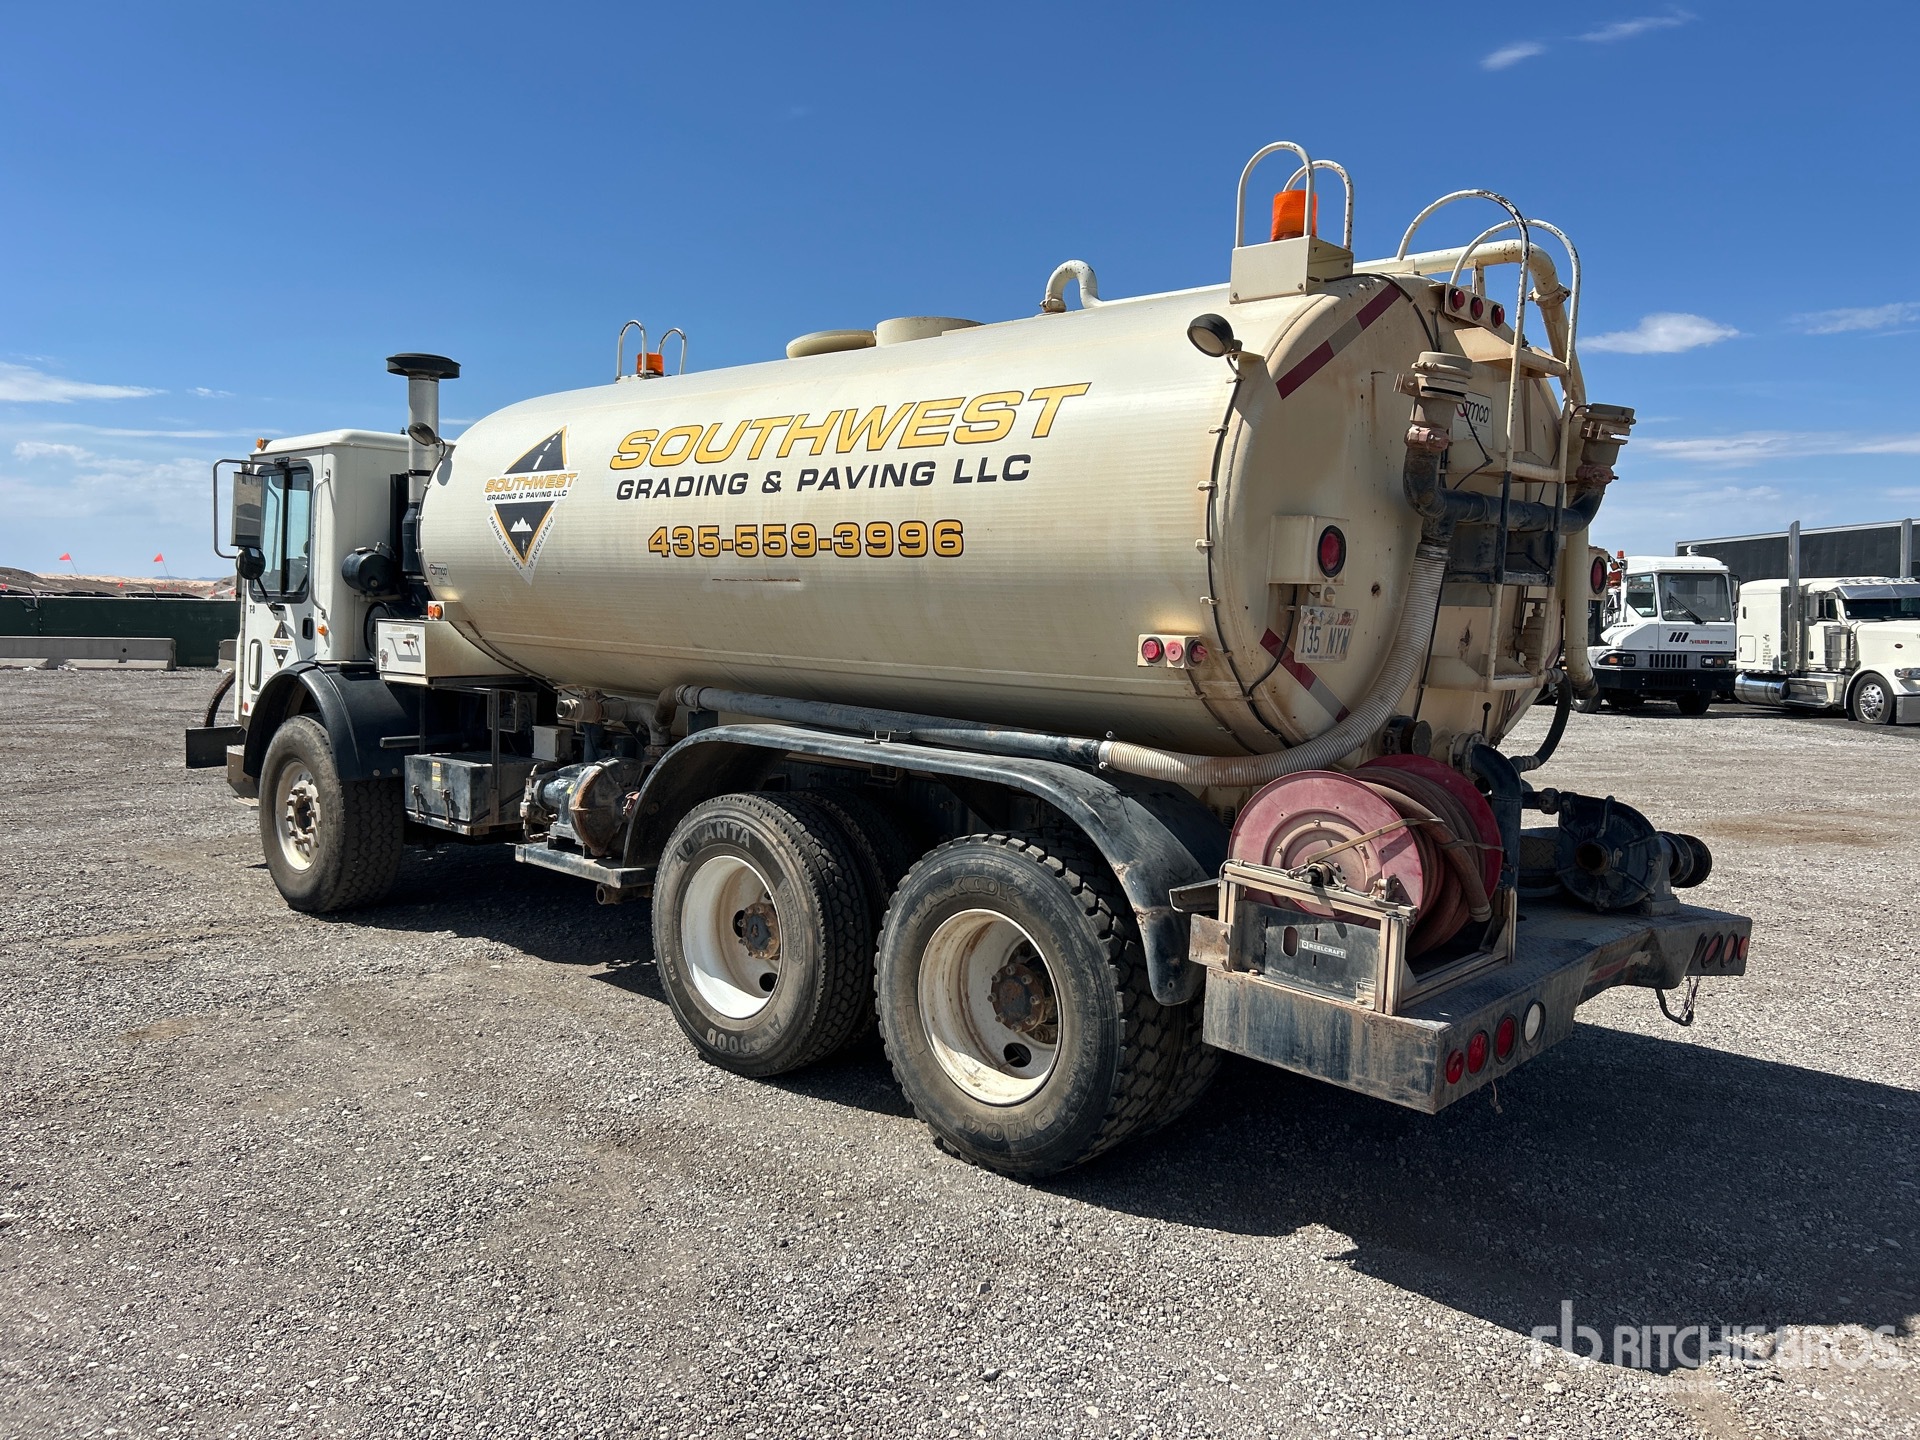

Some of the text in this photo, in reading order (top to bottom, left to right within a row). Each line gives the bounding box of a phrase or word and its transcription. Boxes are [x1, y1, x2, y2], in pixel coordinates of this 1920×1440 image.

[609, 382, 1093, 470] SOUTHWEST
[484, 472, 579, 493] SOUTHWEST
[486, 493, 517, 501] GRADING
[525, 490, 552, 499] PAVING
[616, 454, 1032, 500] GRADING & PAVING LLC
[489, 516, 523, 571] PAVING THE WAY
[528, 516, 554, 570] TO EXCELLENCE
[648, 519, 965, 558] 435-559-3996
[1301, 625, 1321, 653] 135
[908, 875, 1022, 930] HANKOOK
[1309, 943, 1344, 956] REELCRAFT
